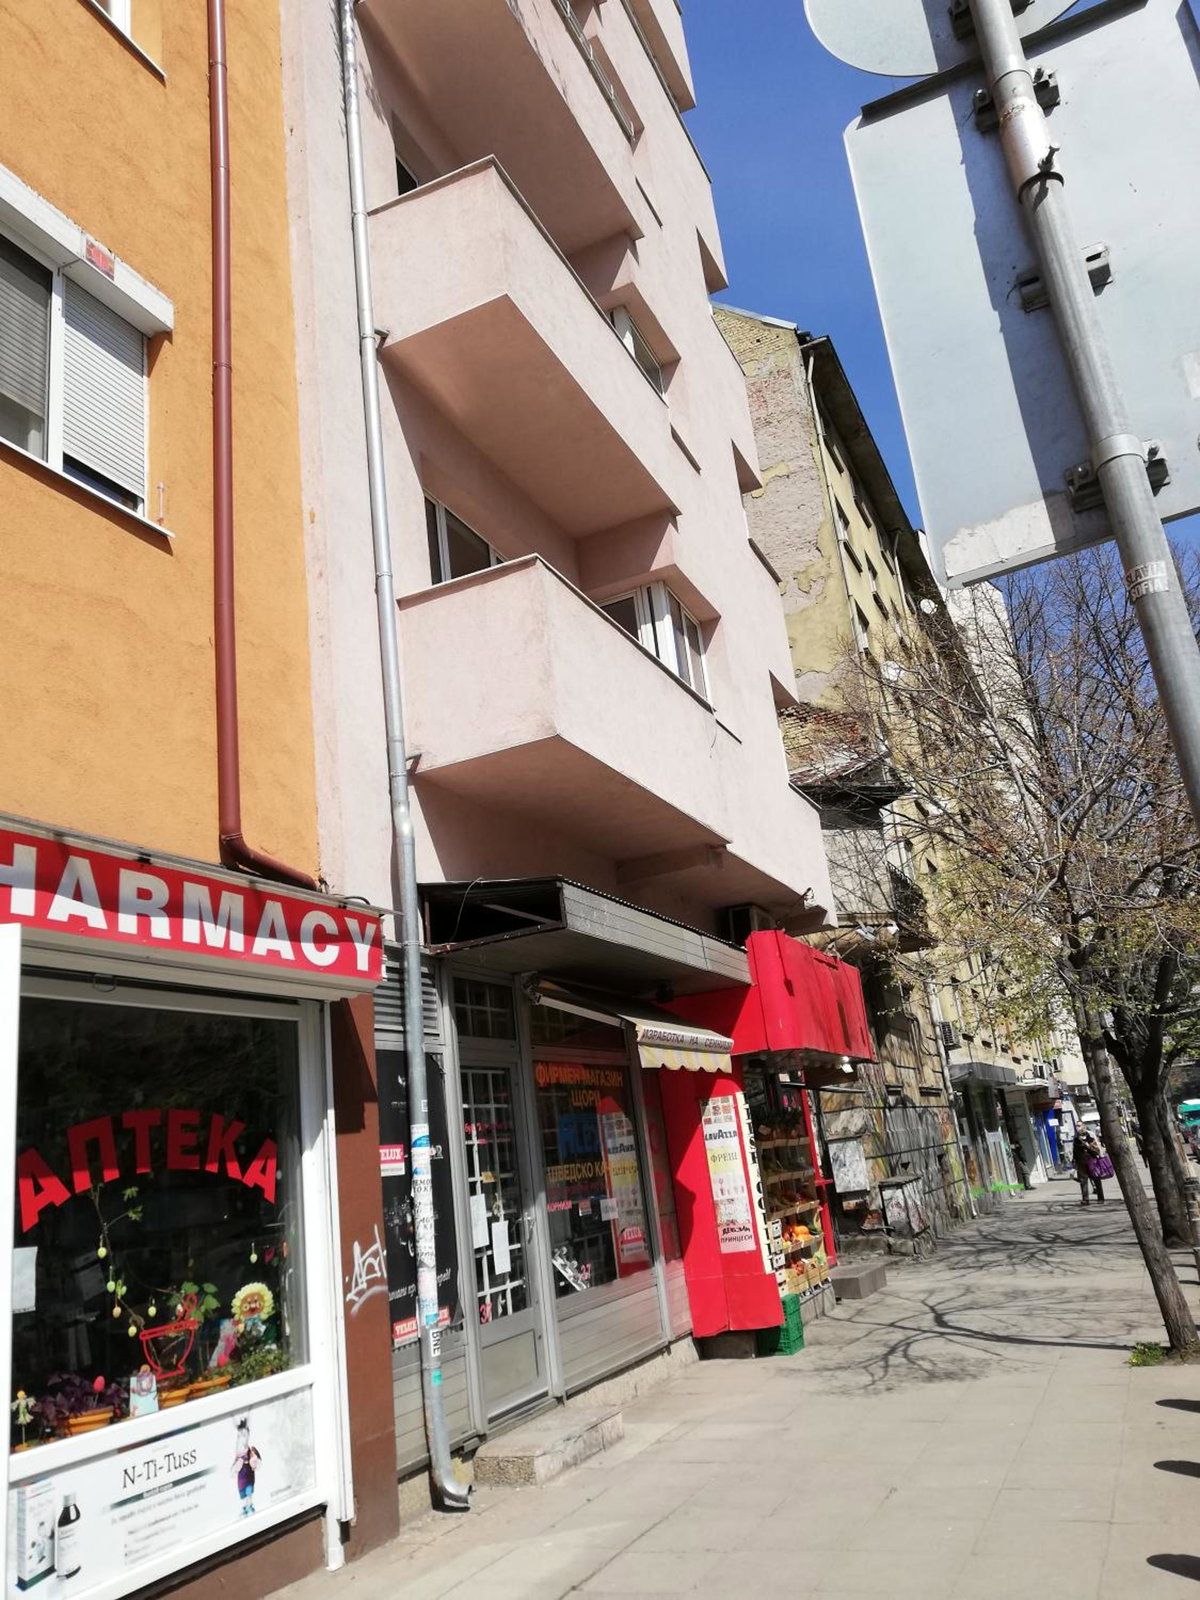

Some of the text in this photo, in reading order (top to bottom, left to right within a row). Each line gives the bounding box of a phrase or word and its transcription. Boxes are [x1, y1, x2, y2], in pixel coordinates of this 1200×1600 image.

[690, 1035, 699, 1046] НА
[18, 1109, 278, 1233] АПТЕКА
[121, 1448, 198, 1490] N-Ti-Tuss
